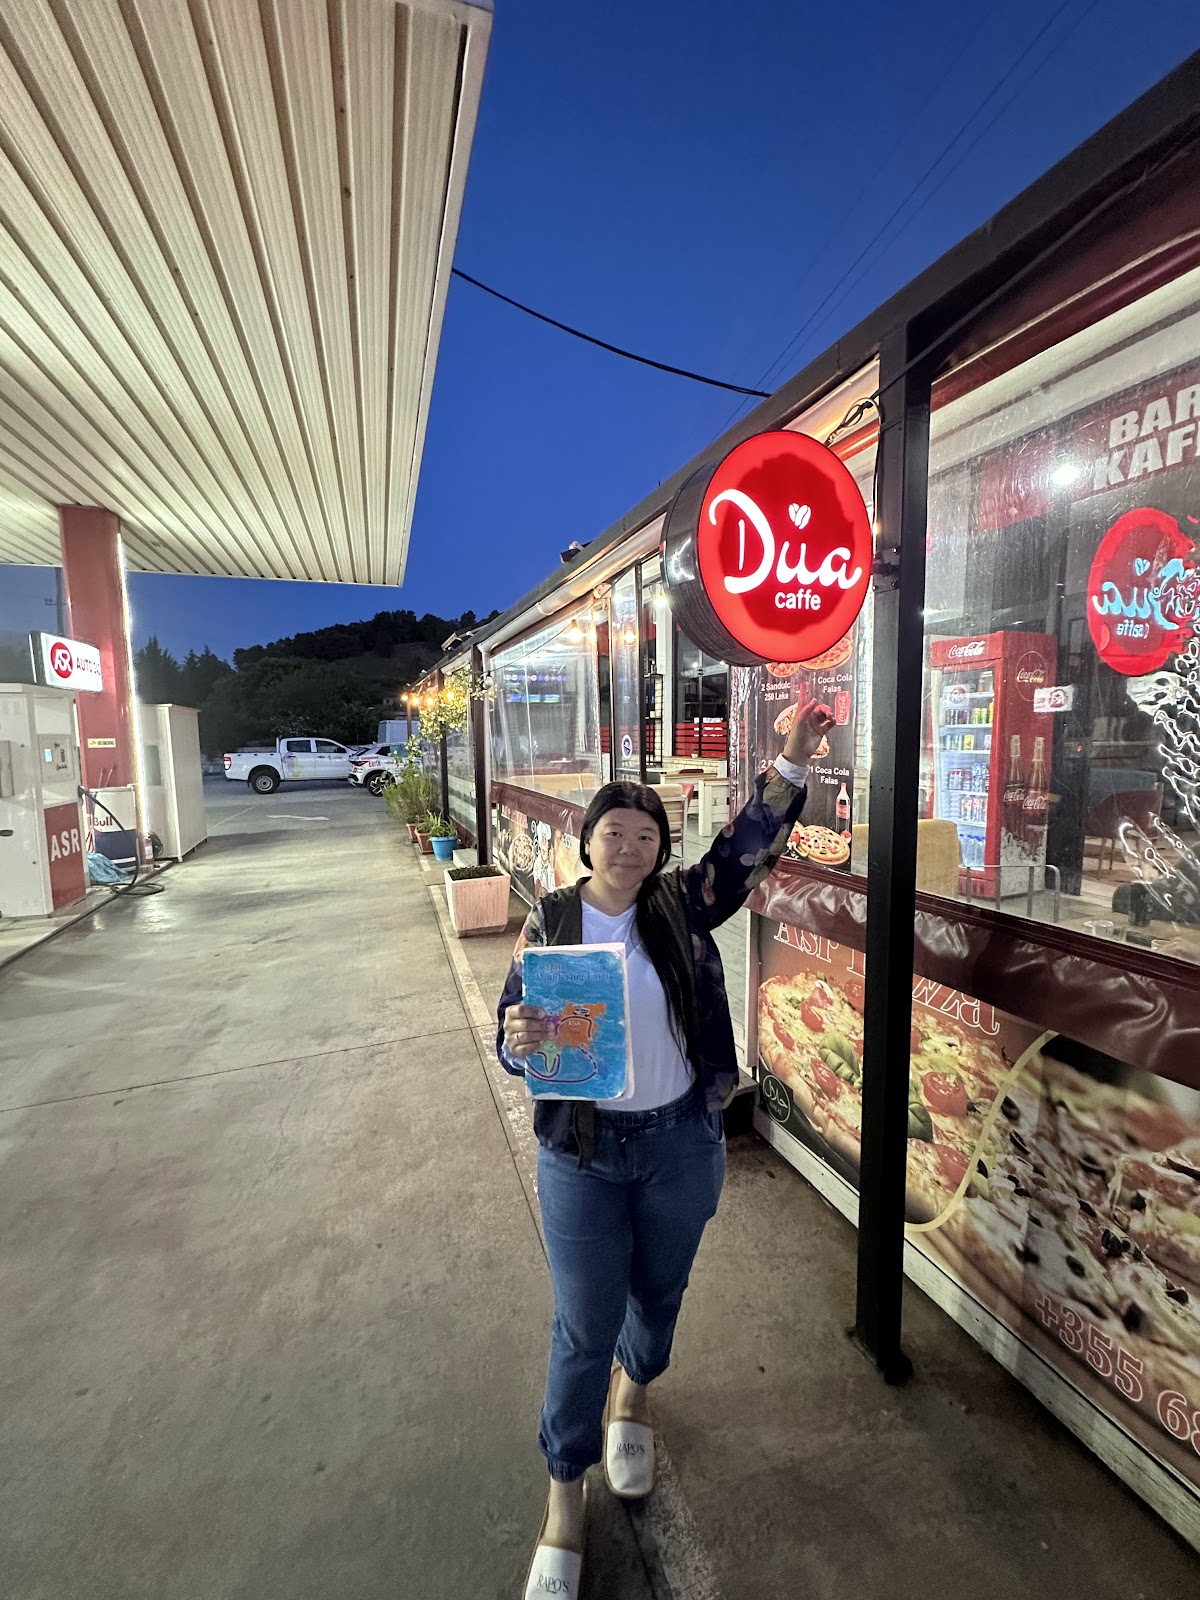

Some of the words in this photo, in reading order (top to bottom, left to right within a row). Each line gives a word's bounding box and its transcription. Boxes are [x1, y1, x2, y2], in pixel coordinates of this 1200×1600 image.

[1109, 384, 1200, 449] BAR
[1093, 421, 1200, 491] KAF
[708, 488, 862, 594] Dua
[774, 589, 822, 611] caffe
[817, 676, 835, 685] Coca
[836, 673, 853, 682] Cola
[815, 766, 832, 775] Coca
[833, 767, 850, 777] Cola
[820, 776, 839, 785] Falas
[51, 828, 80, 862] ASR
[1034, 1295, 1144, 1403] +355
